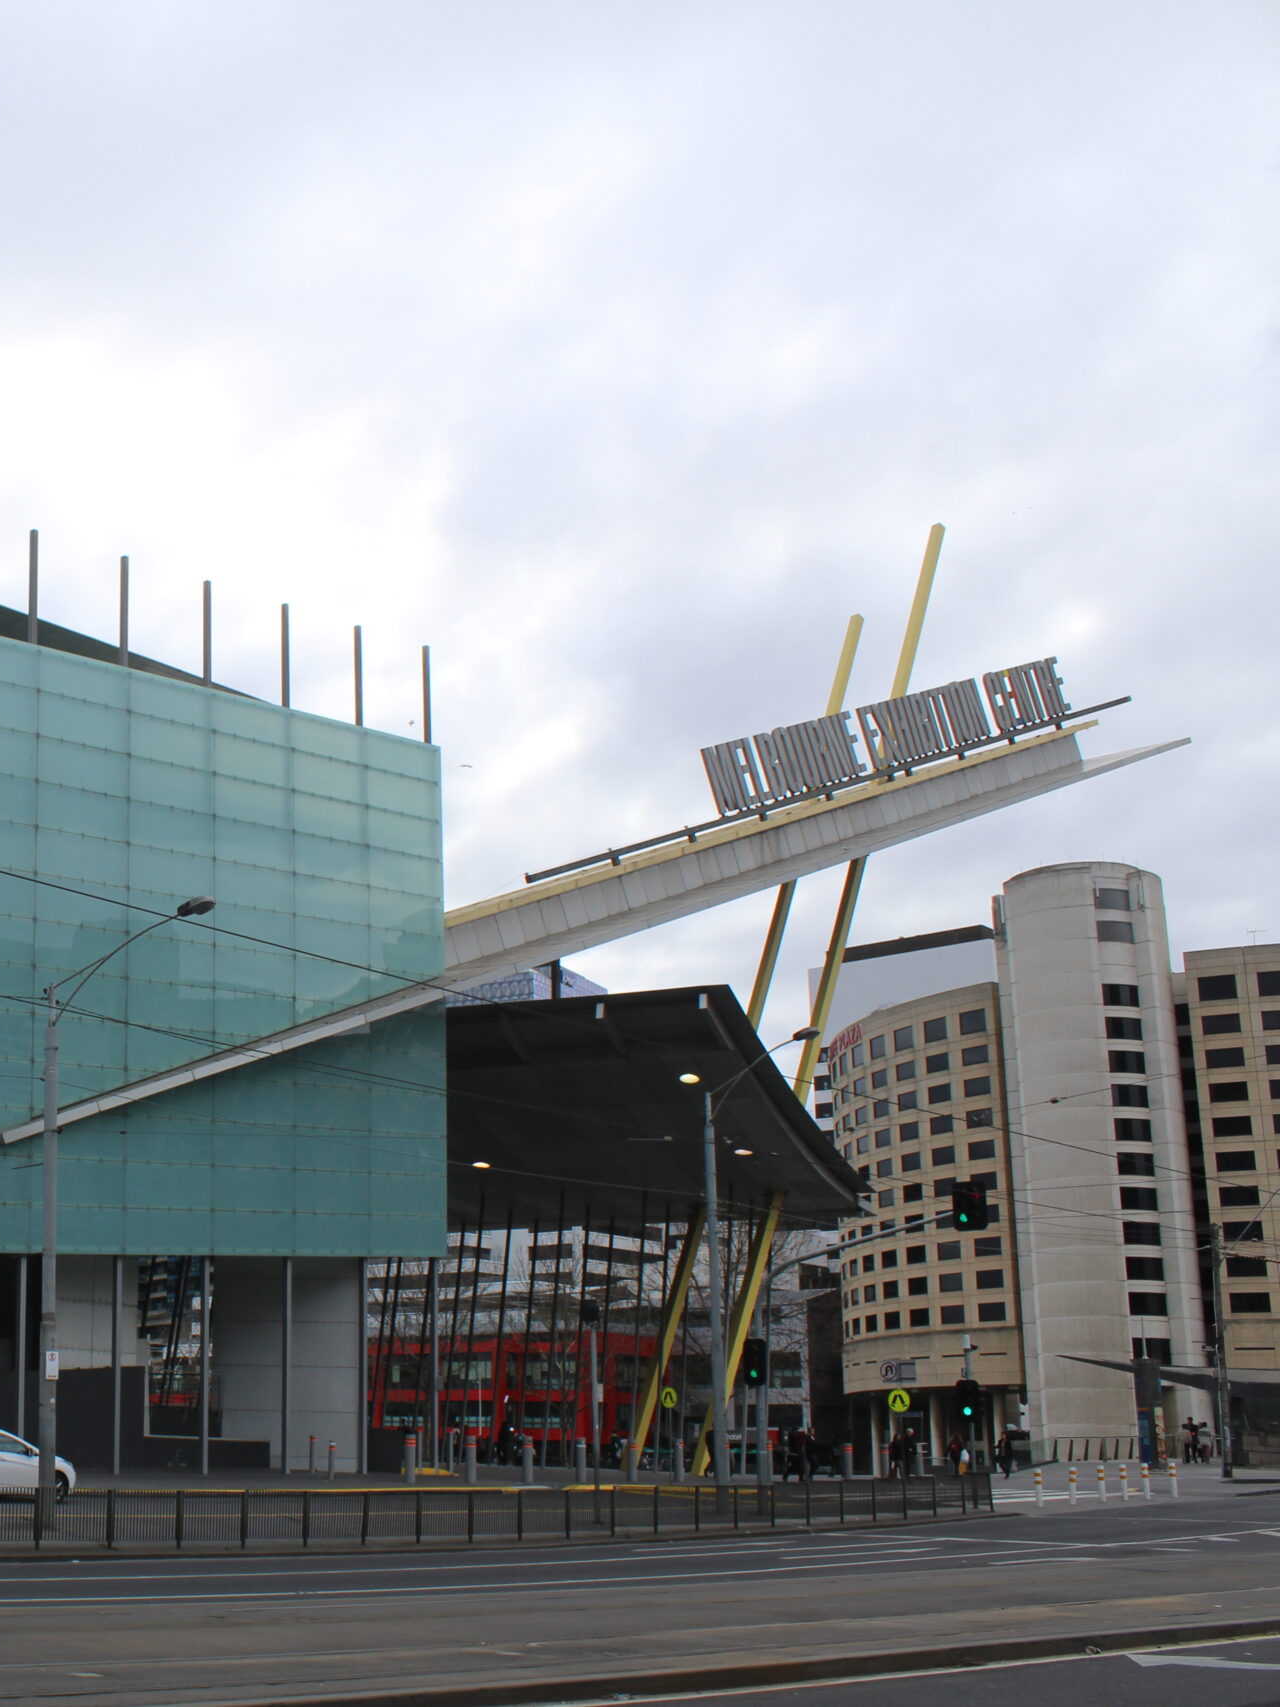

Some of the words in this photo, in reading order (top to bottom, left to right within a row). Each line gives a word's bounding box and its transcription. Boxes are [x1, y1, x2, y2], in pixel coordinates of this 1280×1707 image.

[700, 711, 867, 816] MELBOURNE
[856, 678, 991, 771] EXHIBITION
[982, 656, 1072, 735] CENTRE
